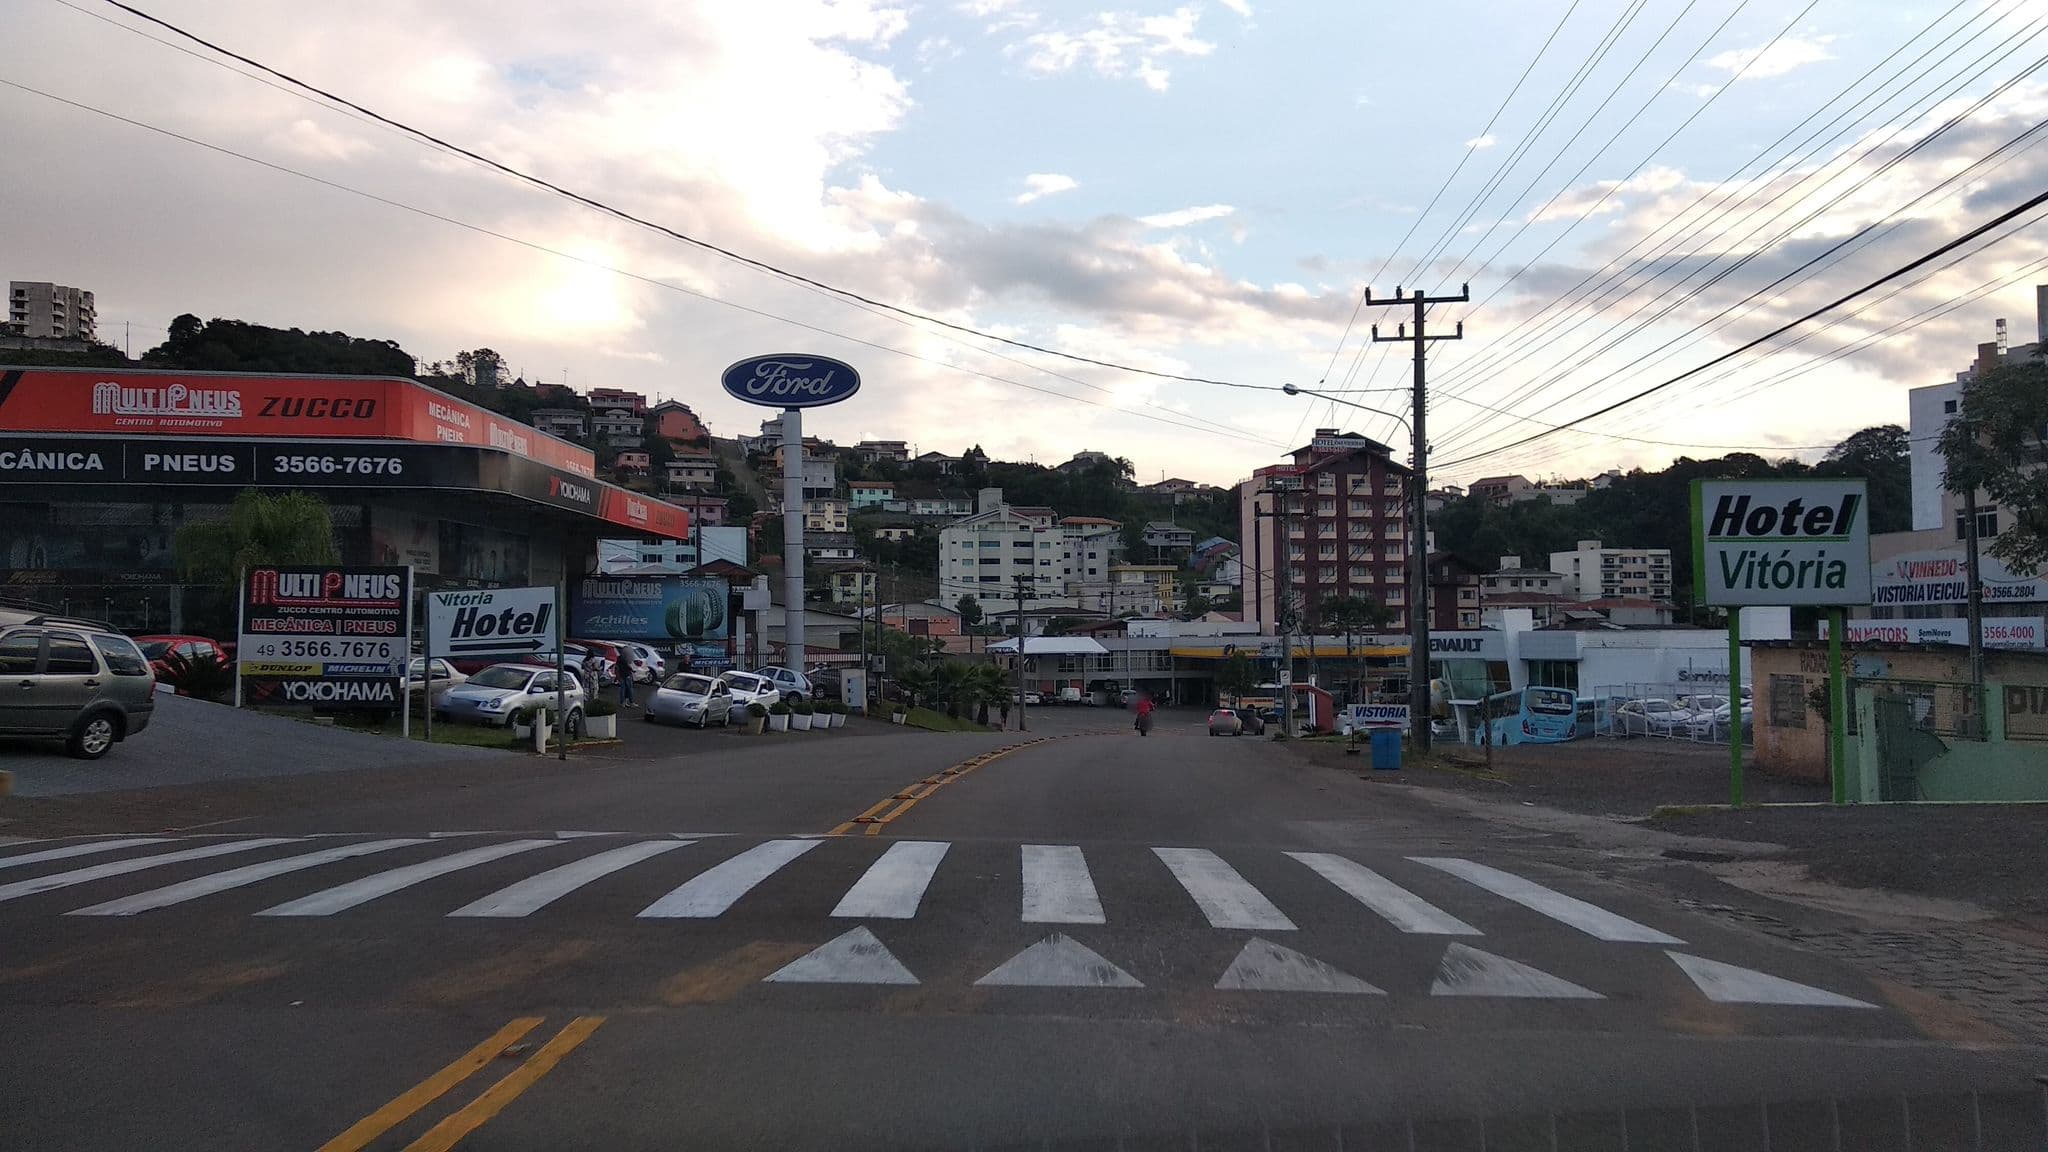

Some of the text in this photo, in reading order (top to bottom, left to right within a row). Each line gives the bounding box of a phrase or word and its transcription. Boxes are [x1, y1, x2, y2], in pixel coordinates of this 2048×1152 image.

[746, 361, 836, 396] Ford
[257, 396, 377, 419] ZUCCO
[428, 401, 471, 430] MECÂNICA
[115, 418, 223, 427] CENTRO AUTOMOTIVO
[437, 424, 465, 443] PNEUS
[144, 453, 236, 472] PNEUS
[273, 455, 403, 475] 3566-7676
[1708, 493, 1862, 536] Hotel
[1719, 549, 1847, 590] Vitória
[1909, 559, 1958, 579] VINHEDO
[1877, 584, 1925, 603] VISTORIA
[1925, 582, 1969, 601] VEICUL
[1990, 585, 2035, 599] 3566.2804
[309, 607, 343, 615] CENTRO
[344, 608, 401, 616] AUTOMOTIVO
[585, 615, 649, 625] Achilles
[251, 616, 397, 634] MECÂNICA PNEUS
[450, 603, 553, 639] Hotel
[1984, 625, 2035, 639] 3566.4000
[256, 640, 391, 658] 49 3566.7676
[1429, 638, 1484, 652] ENAULT
[258, 664, 313, 672] DUNLOP
[327, 664, 386, 673] MICHELIN
[282, 681, 395, 702] YOKOHAMA
[1355, 706, 1407, 718] VISTORIA
